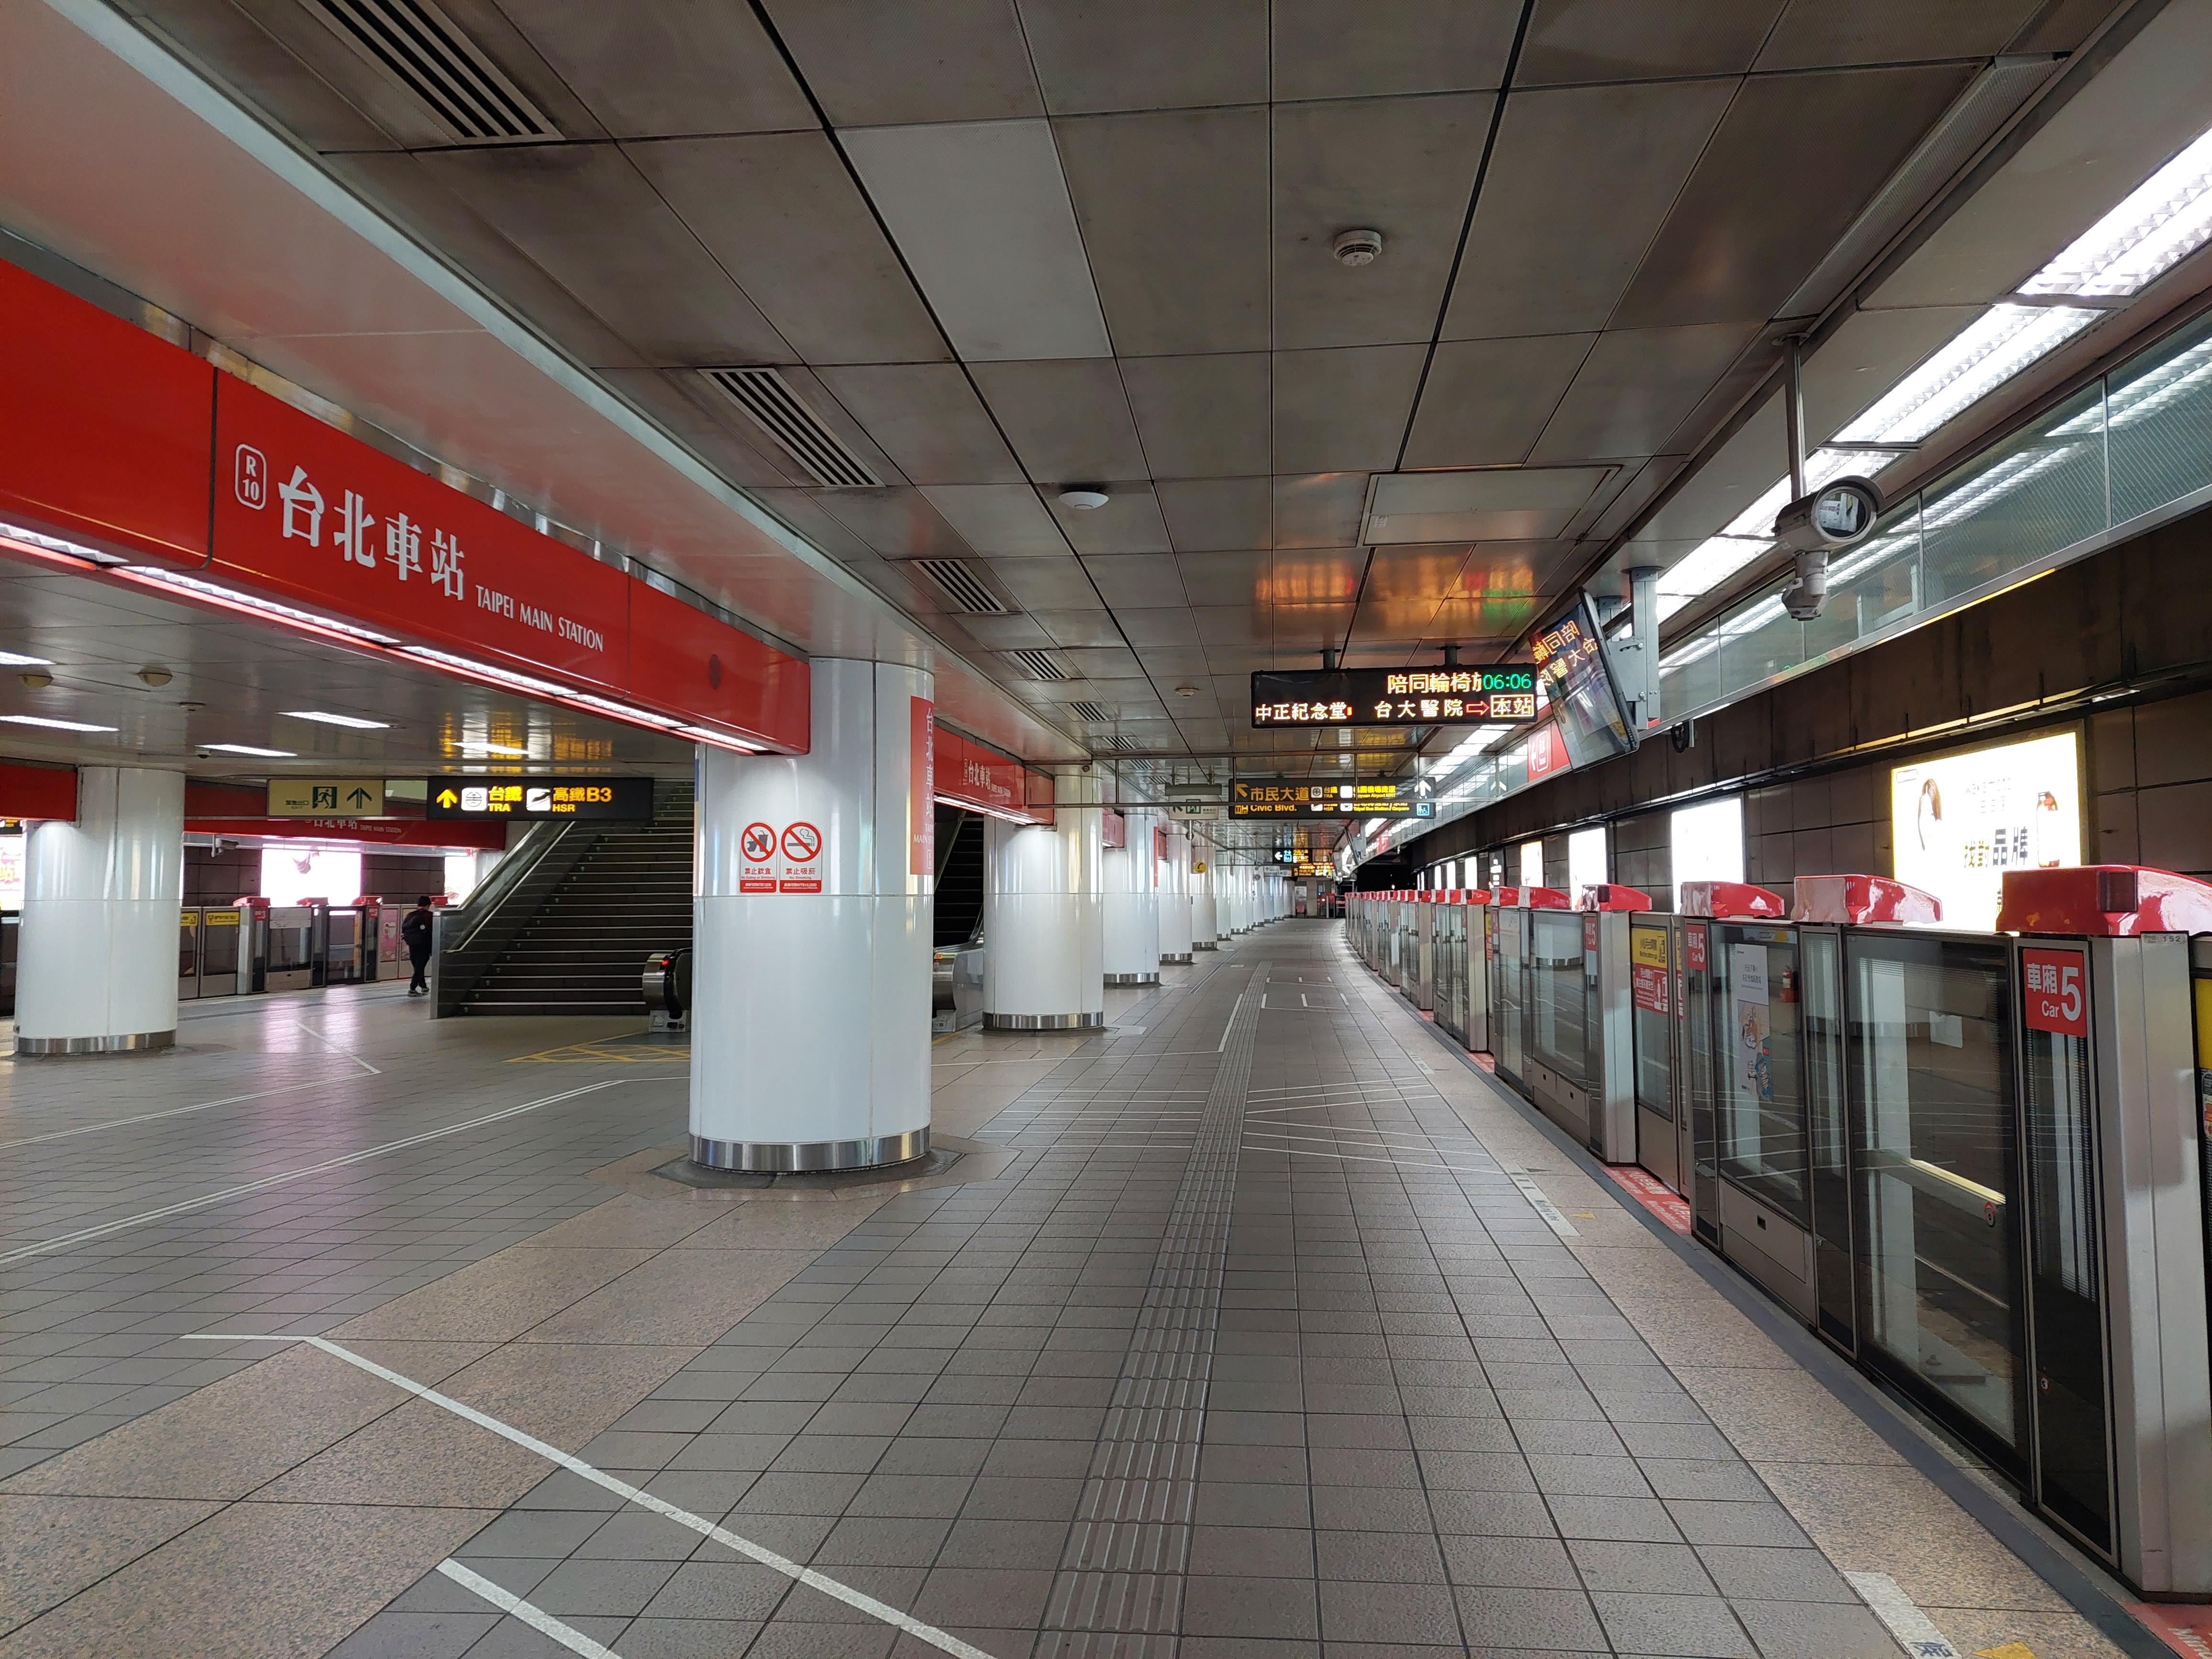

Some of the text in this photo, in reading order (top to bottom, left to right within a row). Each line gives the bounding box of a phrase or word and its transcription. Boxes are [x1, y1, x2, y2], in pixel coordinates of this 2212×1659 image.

[246, 455, 256, 477] R
[243, 478, 259, 501] 10
[278, 465, 464, 601] 台北車站
[476, 585, 603, 652] TAIPEI MAIN STATION
[1483, 674, 1532, 690] 06:06
[1255, 697, 1532, 721] 中正紀念堂 台大醫院 本站
[968, 759, 991, 791] 台北車站
[488, 785, 522, 801] 台鐵
[1250, 786, 1309, 801] 市民大道
[488, 803, 576, 812] TRA HSR
[914, 834, 928, 843] MAIN
[261, 910, 266, 919] 3
[1592, 923, 1596, 946] 5
[1698, 933, 1706, 963] 5
[2026, 962, 2081, 1021] 車廂 5
[2042, 1000, 2059, 1018] Car
